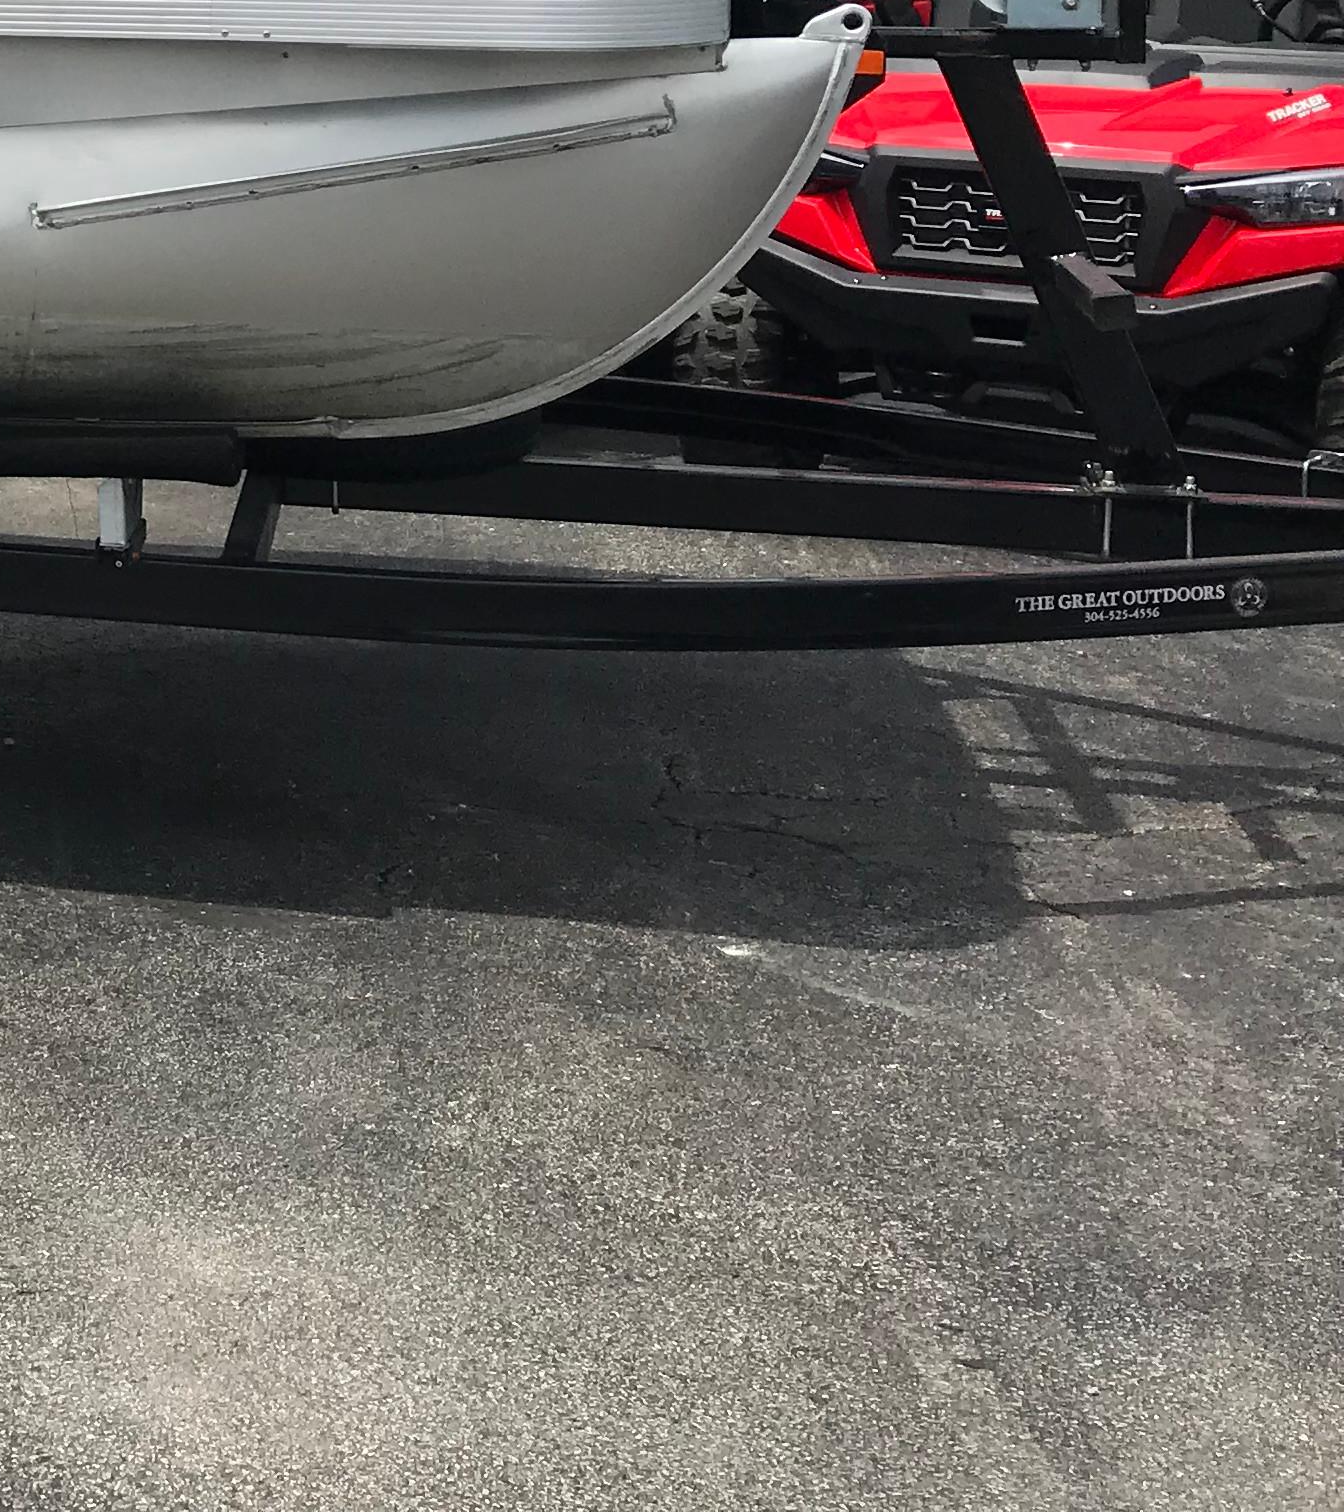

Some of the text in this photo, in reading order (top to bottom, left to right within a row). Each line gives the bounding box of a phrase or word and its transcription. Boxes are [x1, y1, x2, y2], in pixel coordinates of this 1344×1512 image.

[1266, 93, 1327, 122] TRACKER
[1015, 595, 1055, 613] THE
[1058, 590, 1121, 610] GREAT
[1122, 584, 1226, 606] OUTDOORS
[1084, 606, 1161, 623] 304-525-4556
